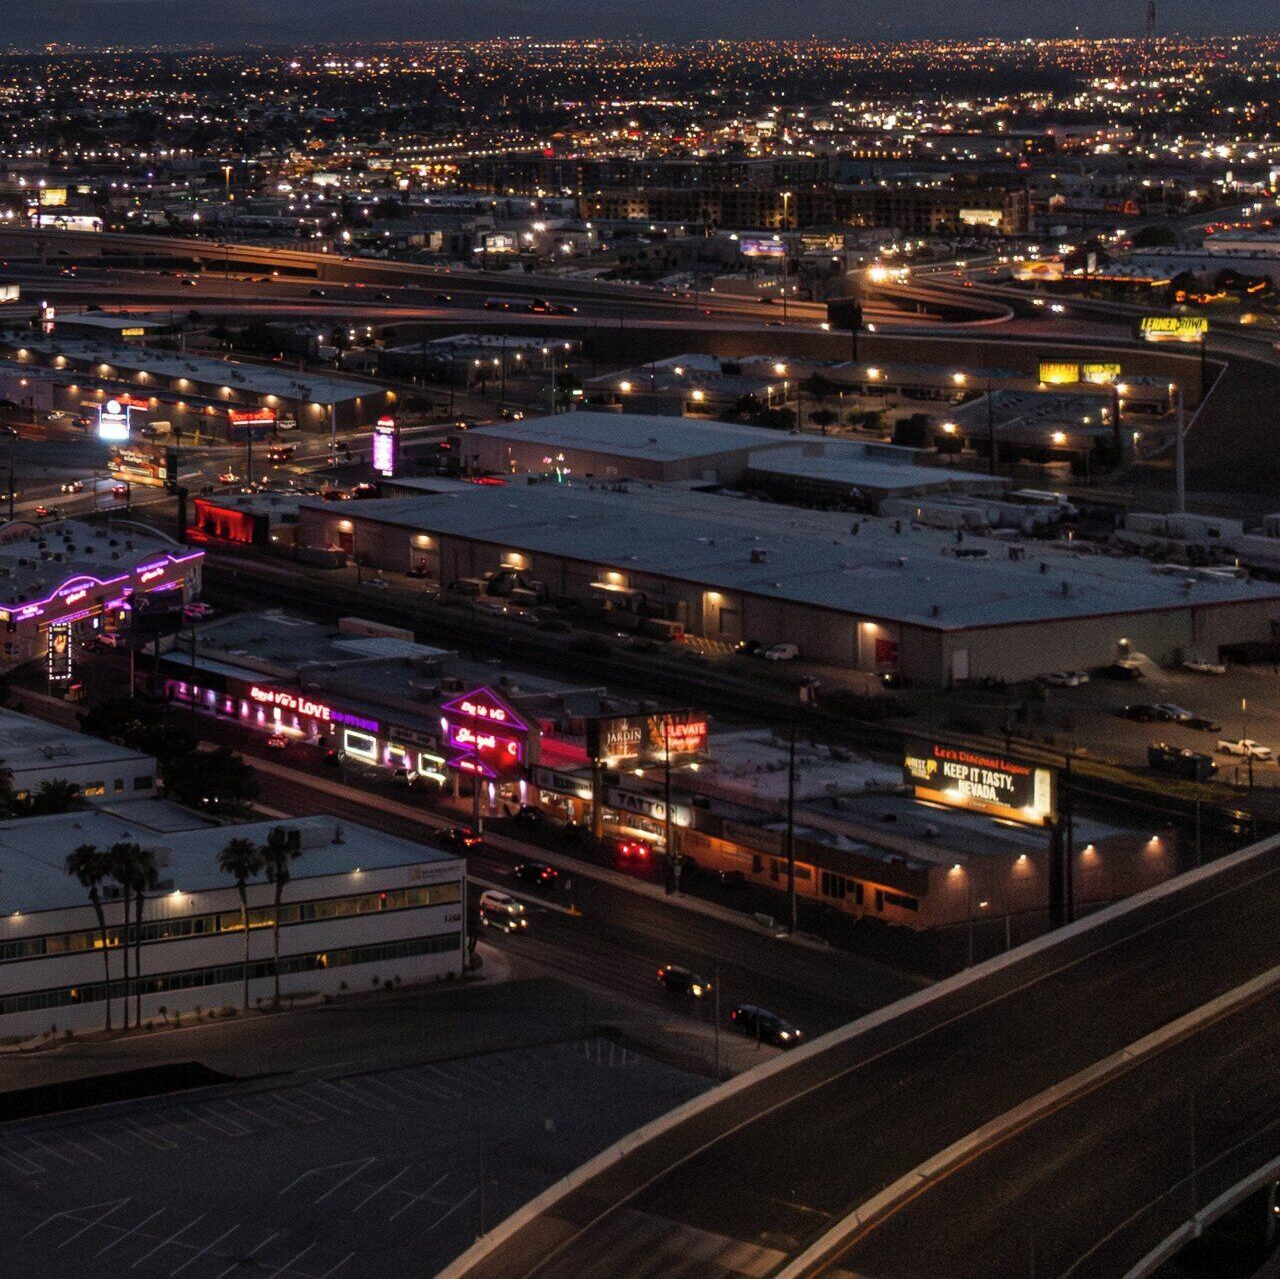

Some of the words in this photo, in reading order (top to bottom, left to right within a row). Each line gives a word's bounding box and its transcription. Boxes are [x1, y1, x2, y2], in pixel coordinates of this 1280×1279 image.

[298, 697, 331, 720] LOVE
[607, 730, 642, 746] JARDIN
[665, 721, 706, 737] ELEVATE
[943, 761, 969, 779] KEEP
[969, 767, 980, 782] IT
[981, 769, 1015, 792] TASTY,
[958, 779, 1000, 802] NEVADA.
